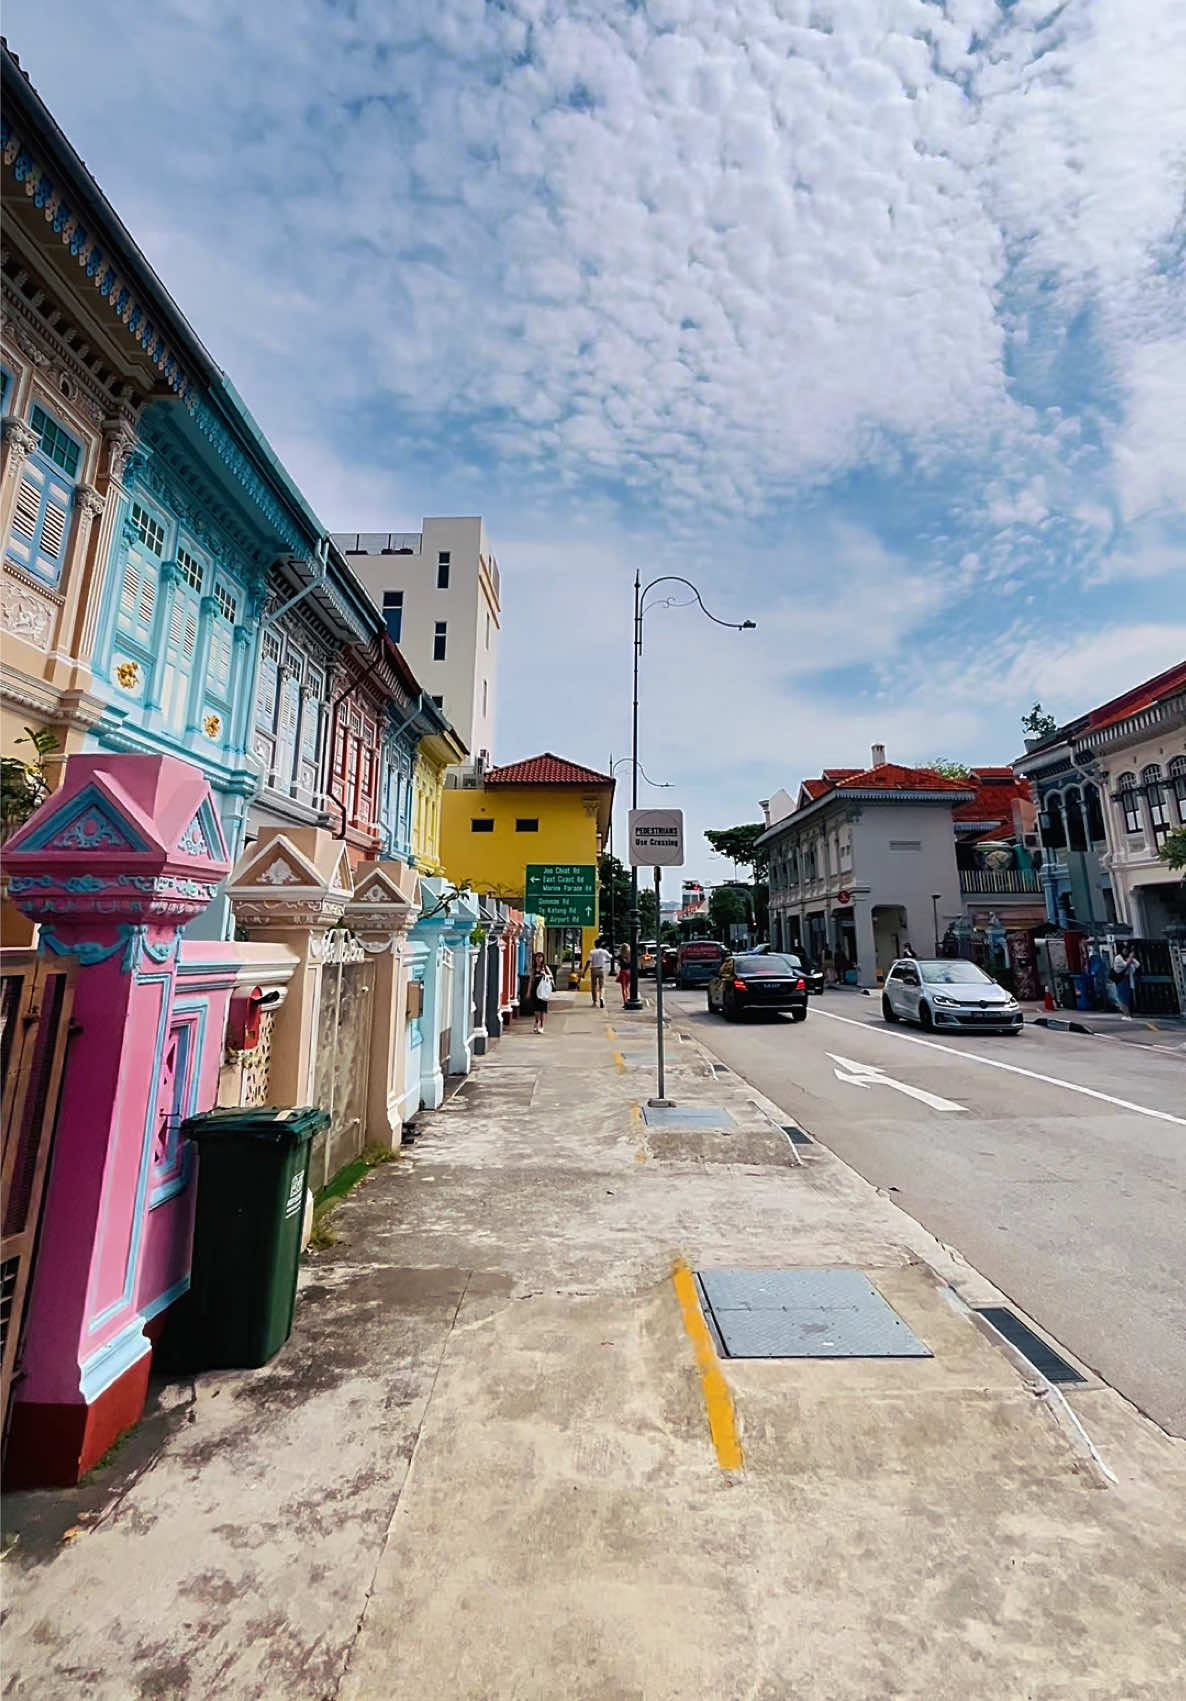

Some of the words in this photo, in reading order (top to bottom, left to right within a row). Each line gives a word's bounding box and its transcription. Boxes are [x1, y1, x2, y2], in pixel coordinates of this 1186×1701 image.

[635, 827, 678, 835] PEDESTRIANS
[635, 838, 648, 846] Use
[650, 838, 678, 847] Crossing
